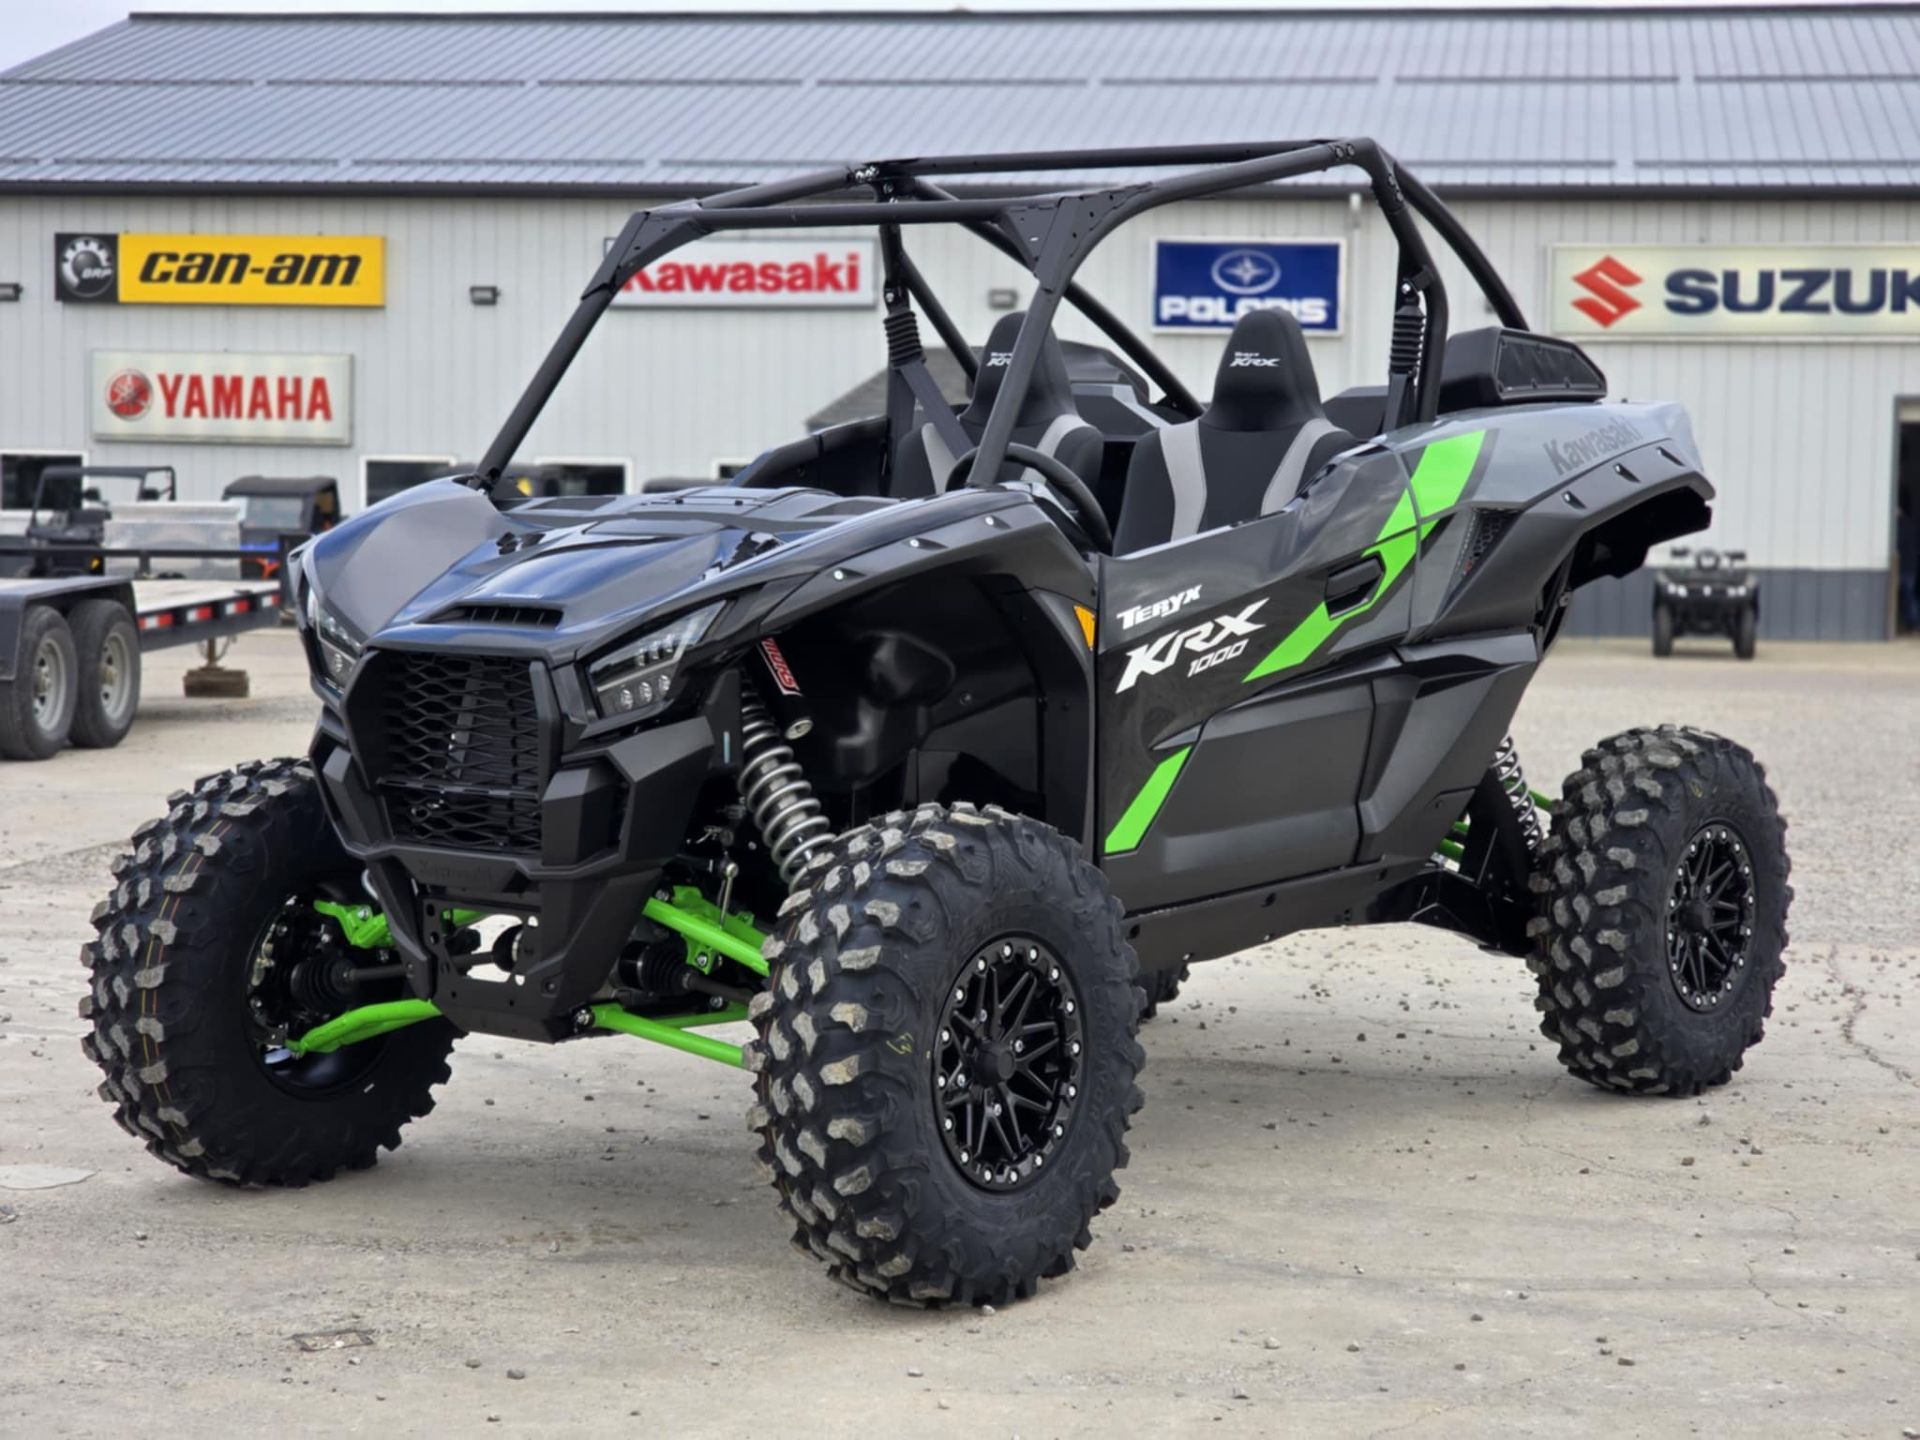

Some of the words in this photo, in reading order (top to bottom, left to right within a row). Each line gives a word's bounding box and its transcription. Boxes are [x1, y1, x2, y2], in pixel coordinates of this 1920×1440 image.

[1229, 357, 1281, 368] KRX
[157, 374, 333, 421] YAMAHA
[1542, 415, 1643, 476] Kawasaki
[1115, 597, 1271, 694] KRX
[1187, 638, 1250, 678] 1000
